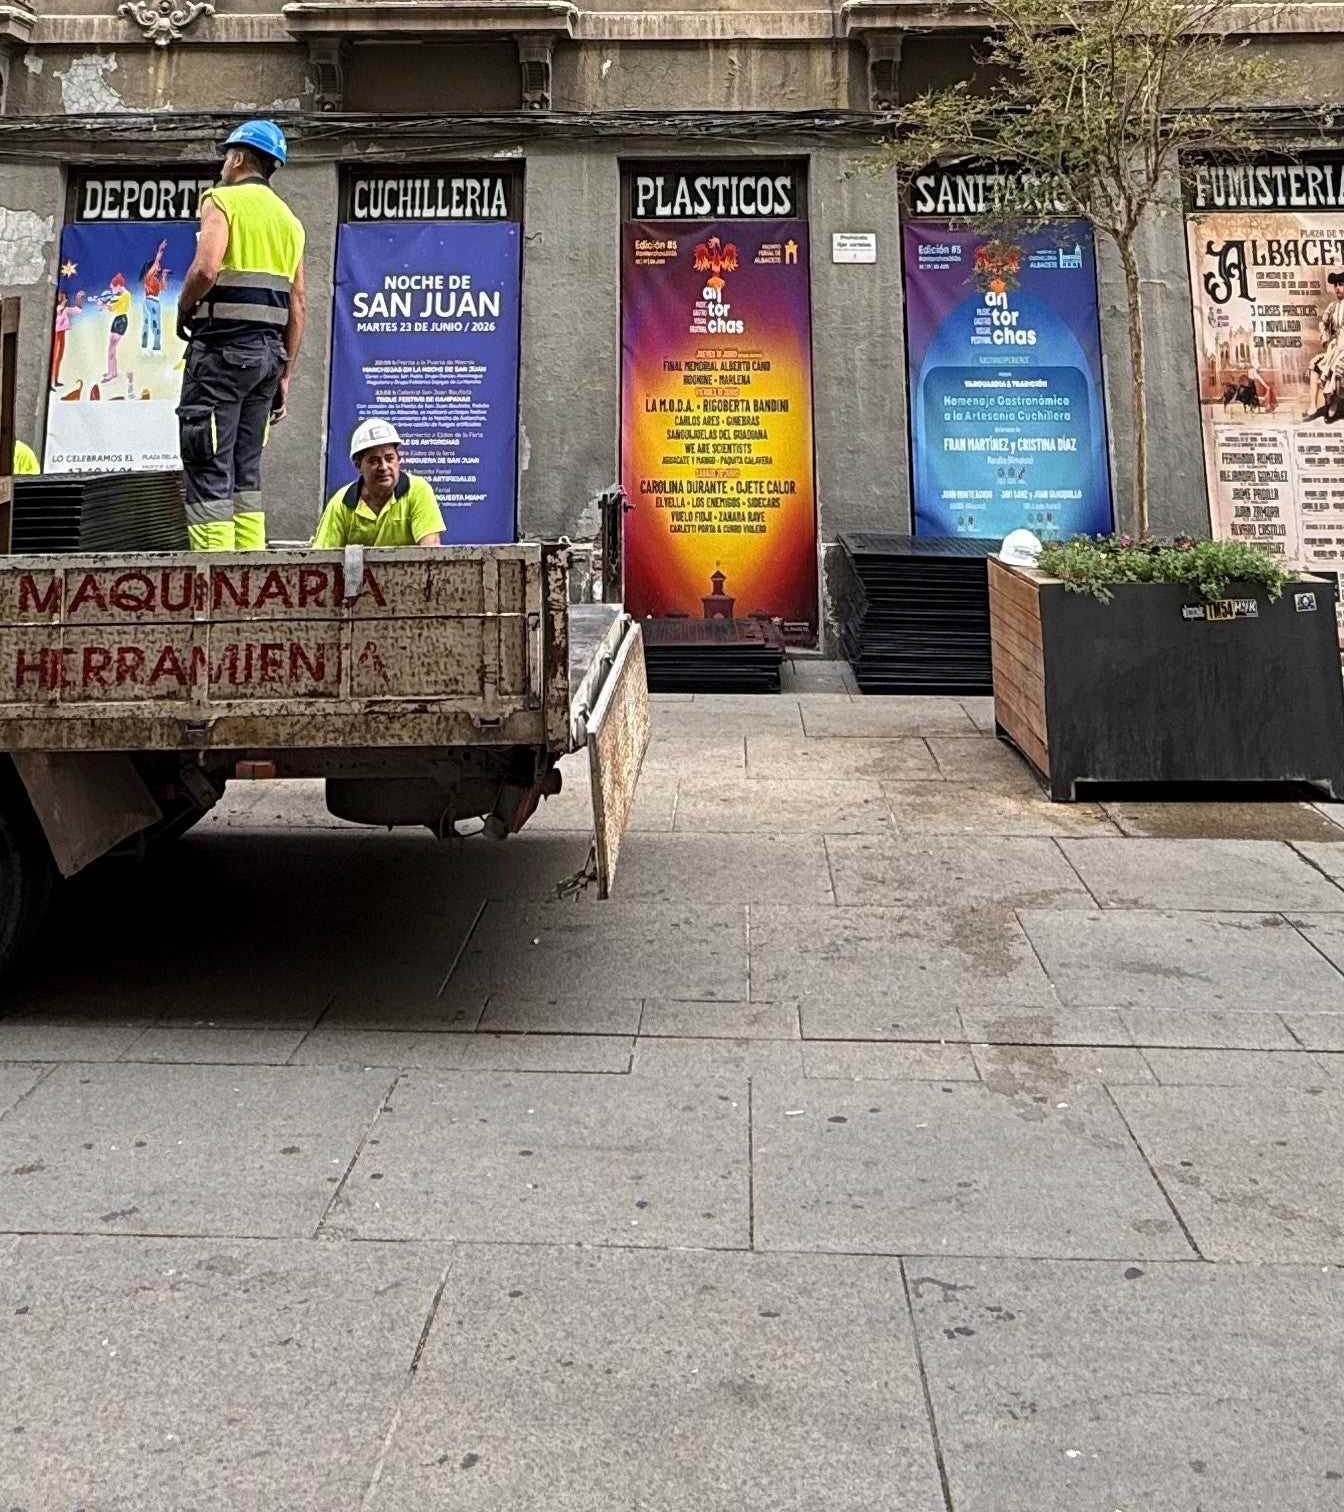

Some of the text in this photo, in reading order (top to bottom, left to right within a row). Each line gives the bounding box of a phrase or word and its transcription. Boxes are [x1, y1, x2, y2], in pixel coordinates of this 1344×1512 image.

[355, 178, 507, 218] CUCHILLERIA
[637, 176, 791, 215] PLASTICOS
[635, 240, 665, 250] Edición
[919, 245, 949, 254] Edición
[385, 275, 471, 289] NOCHE DE
[353, 292, 500, 317] SAN JUAN
[707, 303, 730, 316] tor
[991, 309, 1019, 325] tor
[357, 323, 397, 331] MARTES
[400, 323, 411, 331] 23
[415, 323, 428, 331] DE
[430, 322, 462, 331] JUNIO
[471, 322, 495, 331] 2026
[708, 319, 744, 333] chas
[993, 327, 1037, 345] chas
[720, 361, 749, 371] ALBERTO
[646, 399, 789, 412] LA M.O.D.A. RIGOBERTA BANDINI
[944, 395, 1070, 408] Homenaje Gastronómico
[675, 416, 759, 426] CARLOS ARES GINEBRAS
[944, 413, 950, 421] a
[953, 411, 963, 421] la
[1018, 411, 1071, 421] Cuchillera
[719, 430, 731, 439] DEL
[685, 444, 751, 453] WE ARE SCIENTISTS
[944, 436, 1077, 454] FRAN MARTÍNEZ y CRISTINA DÍAZ
[641, 481, 796, 494] CAROLINA DURANTE OJETE CALOR
[692, 498, 704, 508] LOS
[18, 568, 387, 615] MAQUINARIA
[16, 641, 389, 689] HERRAMIENTA
